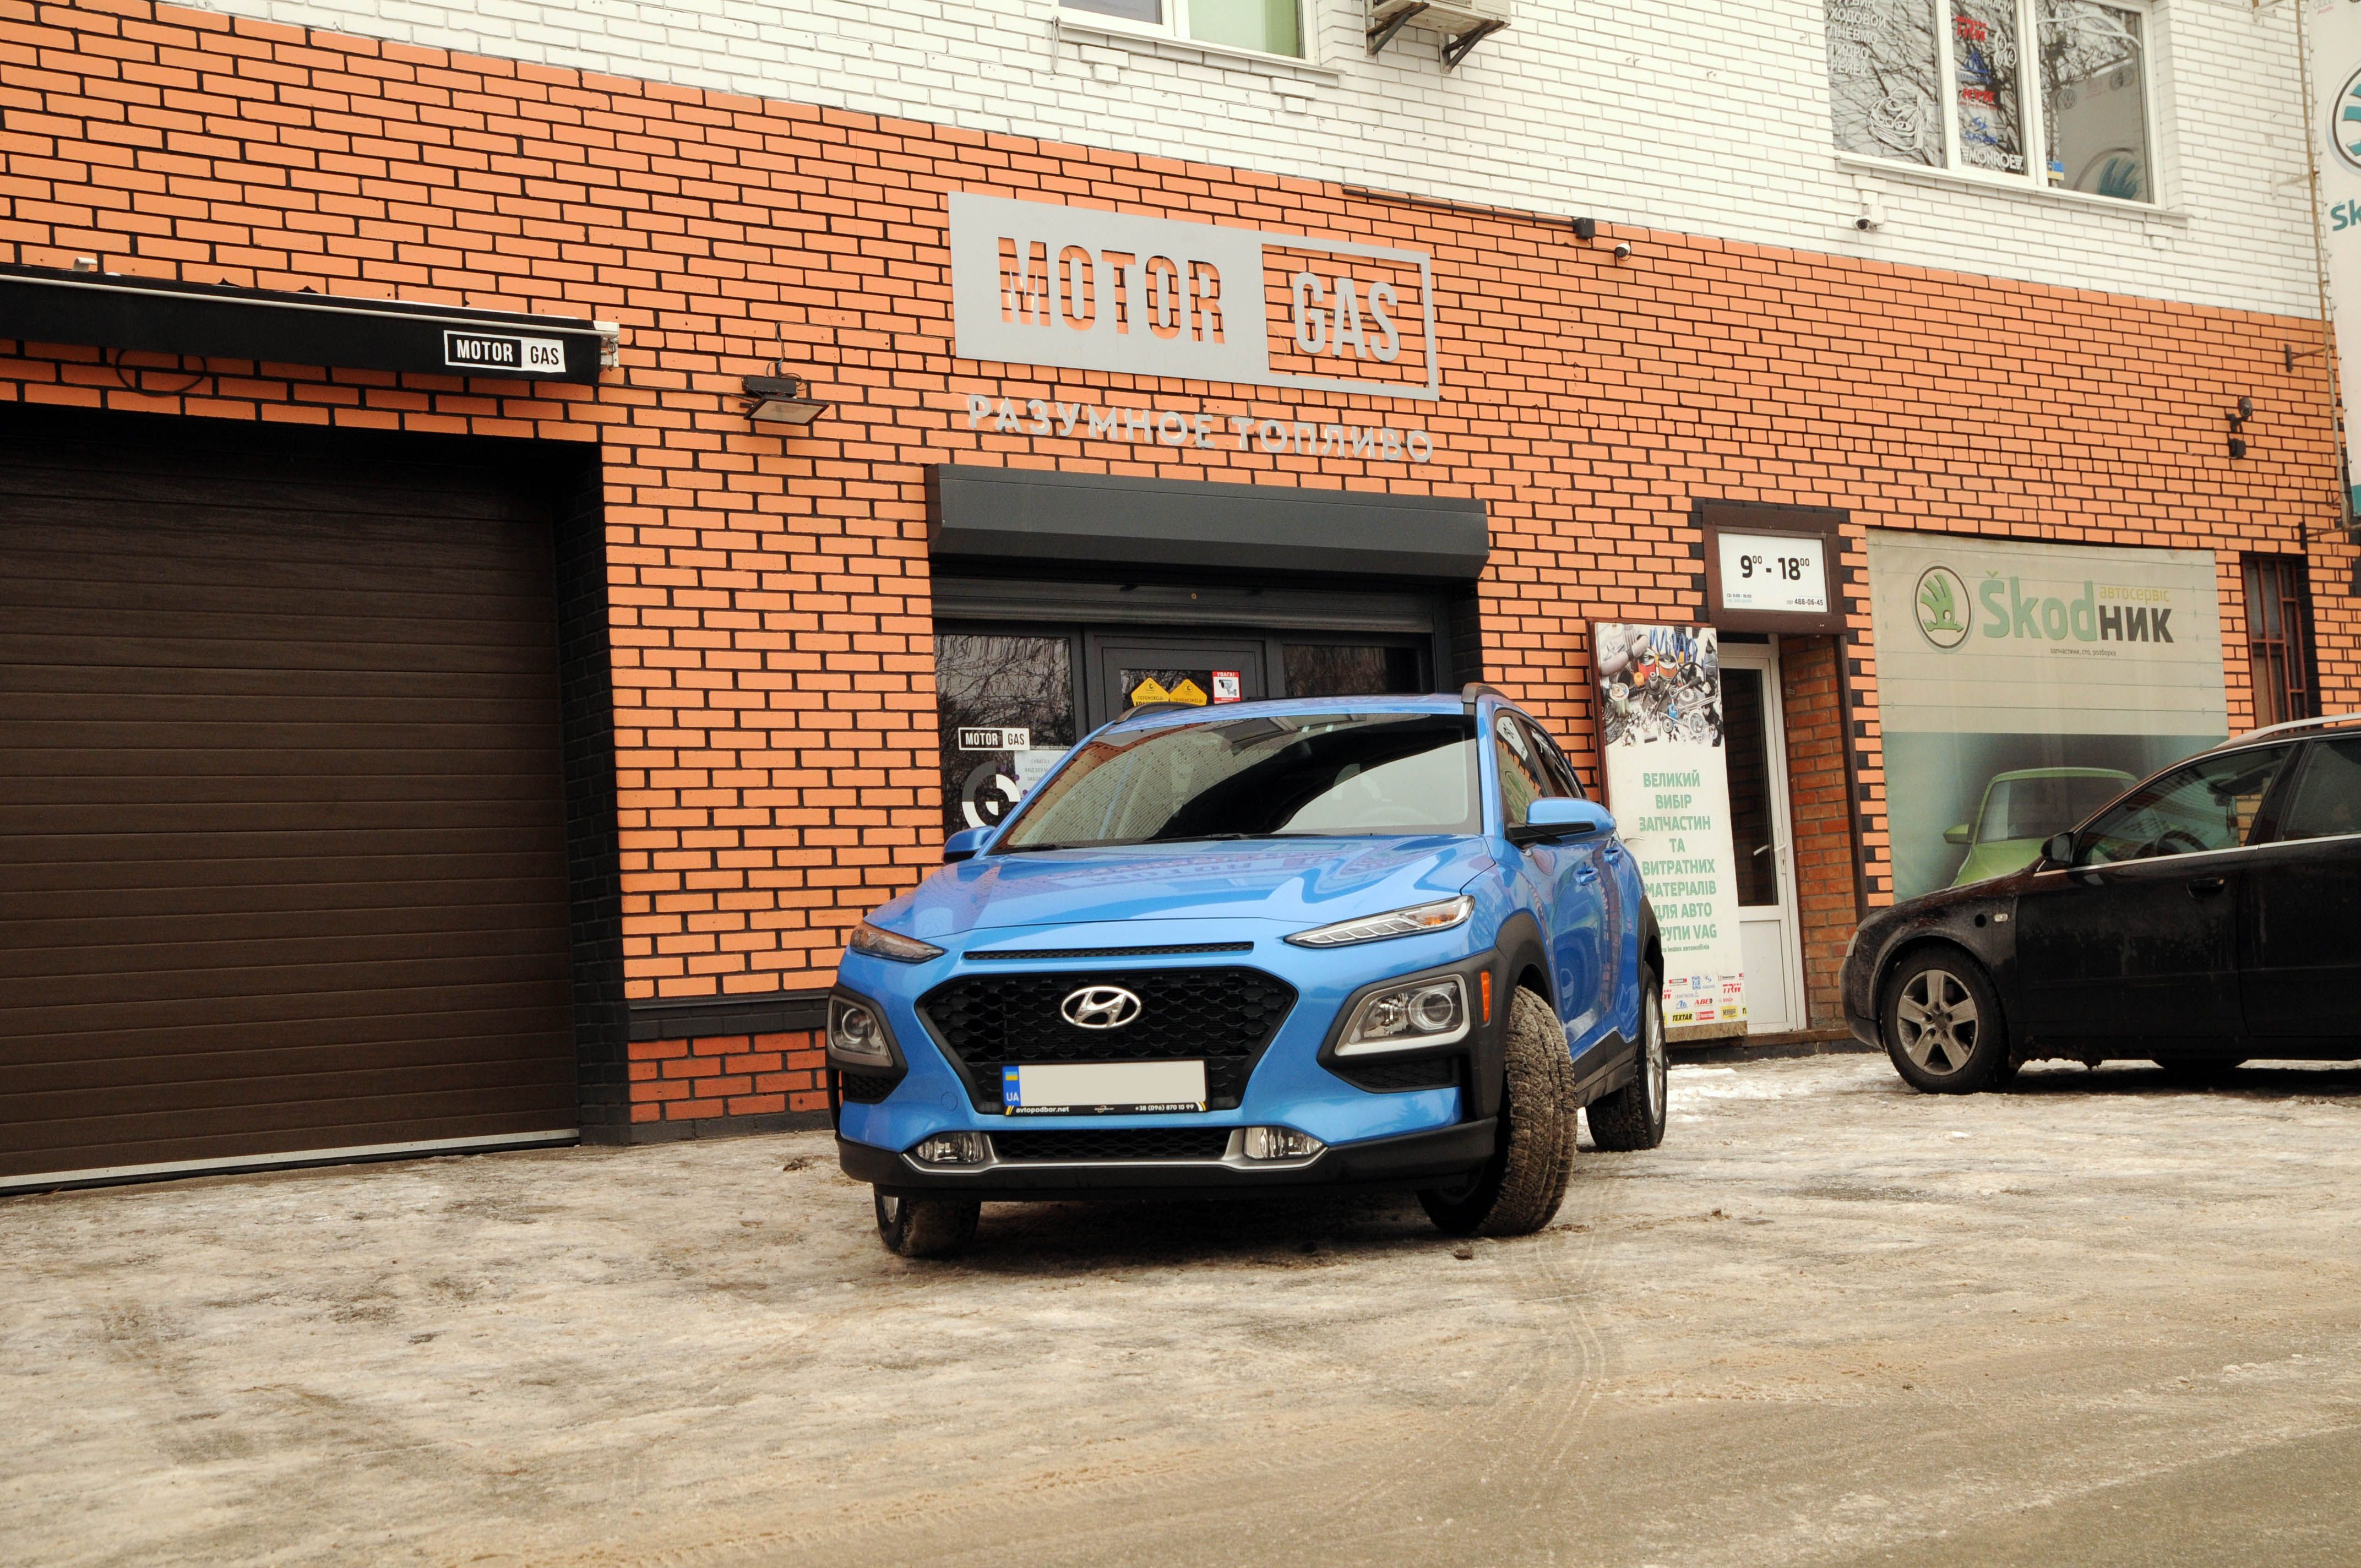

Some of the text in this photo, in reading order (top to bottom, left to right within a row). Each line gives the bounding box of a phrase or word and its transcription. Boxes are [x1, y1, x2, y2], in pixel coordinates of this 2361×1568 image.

[1969, 148, 2016, 169] MONROE
[998, 236, 1400, 362] MOTOR GAS
[456, 339, 559, 365] MOTOR GAS
[968, 394, 1433, 463] РАЗУМНОЕ ТОПЛИВО
[1794, 598, 1824, 606] 488-06-45
[2099, 585, 2170, 605] автосервіс
[965, 733, 1025, 745] MOTOR GAS
[1643, 769, 1700, 787] ВЕЛИКИЙ
[1655, 794, 1692, 809] ВИБІР
[1639, 815, 1711, 831] ЗАПЧАСТИН
[1669, 838, 1685, 852] ТА
[1642, 859, 1716, 876] ВИТРАТНИХ
[1645, 880, 1717, 897] МАТЕРІАЛІВ
[1653, 902, 1712, 922] ДЛЯ АВТО
[1660, 924, 1717, 941] РУПИ VAG
[1722, 983, 1742, 994] TRW
[1672, 1014, 1693, 1022] TEXTAR
[1007, 1092, 1019, 1101] UA
[1015, 1105, 1069, 1114] avtopodbor.net
